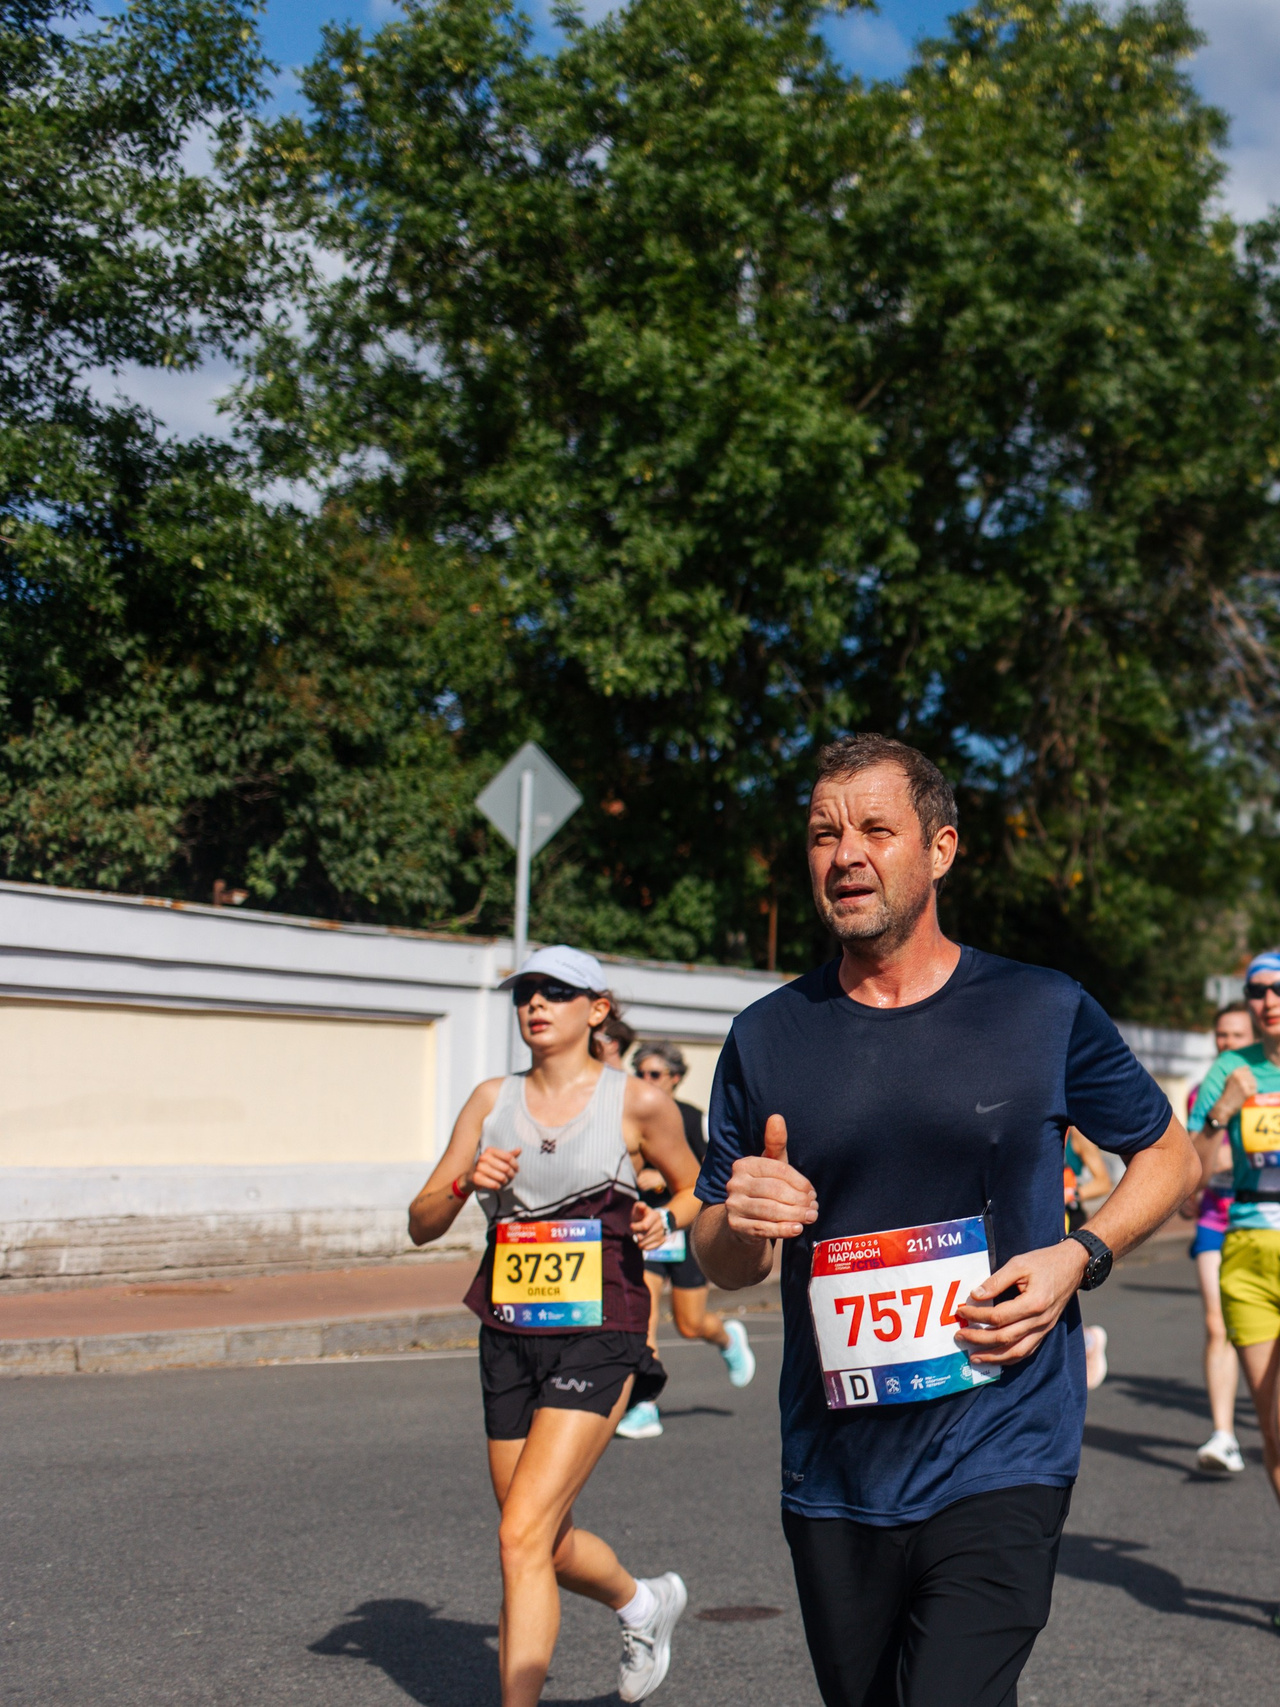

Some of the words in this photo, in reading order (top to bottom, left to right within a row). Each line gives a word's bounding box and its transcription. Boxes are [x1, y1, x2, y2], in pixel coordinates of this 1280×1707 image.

[550, 1227, 567, 1239] 21,1
[906, 1238, 933, 1254] 21,1
[937, 1231, 963, 1247] КМ
[828, 1240, 853, 1253] ПОЛУ
[855, 1239, 878, 1248] 2026
[828, 1247, 881, 1263] МАРАФОН
[506, 1252, 585, 1284] 3737
[527, 1287, 560, 1296] ОЛЕСЯ
[833, 1279, 969, 1348] 7574
[849, 1374, 869, 1401] D
